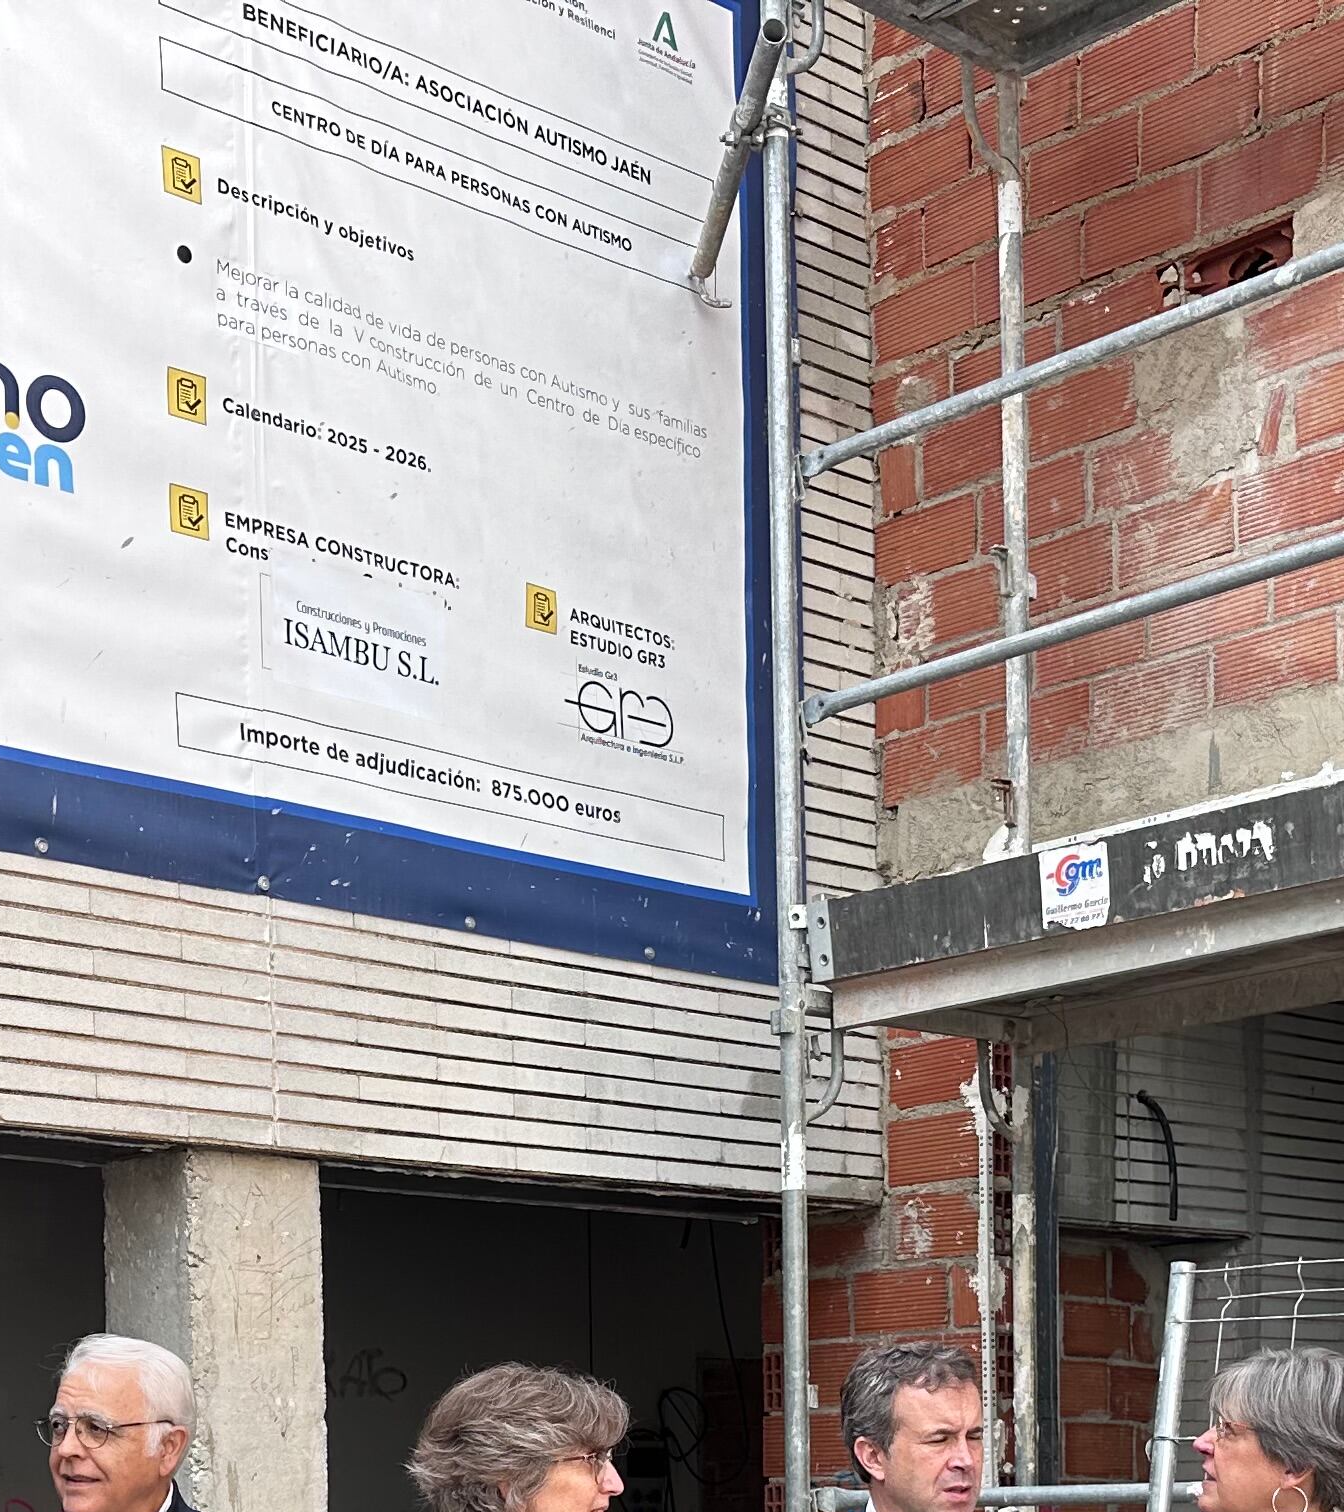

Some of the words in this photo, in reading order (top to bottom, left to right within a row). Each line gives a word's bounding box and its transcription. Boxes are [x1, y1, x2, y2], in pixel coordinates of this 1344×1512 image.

[243, 2, 409, 86] BENEFICIARIO/A:
[416, 75, 528, 136] ASOCIACIÓN
[535, 125, 607, 166] AUTISMO
[611, 156, 651, 185] JAÉN
[271, 101, 341, 137] CENTRO
[346, 128, 366, 150] DE
[371, 140, 399, 164] DÍA
[406, 151, 446, 181] PARA
[451, 170, 530, 213] PERSONAS
[535, 204, 567, 227] CON
[572, 219, 632, 251] AUTISMO
[218, 178, 319, 228] Descripción
[324, 219, 334, 235] y
[339, 226, 414, 261] objetivos
[216, 259, 279, 292] Mejorar
[285, 280, 298, 299] la
[305, 290, 361, 320] calidad
[365, 311, 383, 329] de
[389, 321, 421, 343] vida
[427, 326, 445, 350] de
[451, 341, 515, 375] personas
[520, 366, 546, 385] con
[551, 373, 608, 406] Autismo
[611, 397, 620, 412] y
[629, 403, 650, 420] sus
[658, 409, 707, 439] familias
[217, 312, 255, 335] para
[261, 325, 337, 359] personas
[341, 348, 371, 371] con
[217, 288, 226, 301] a
[237, 291, 288, 321] través
[299, 312, 319, 330] de
[330, 319, 343, 338] la
[354, 327, 364, 343] V
[369, 334, 465, 380] construcción
[474, 369, 492, 389] de
[500, 381, 517, 398] un
[527, 388, 575, 417] Centro
[583, 408, 600, 425] de
[608, 415, 630, 436] Día
[634, 427, 701, 459] específico
[222, 397, 322, 440] Calendario:
[327, 428, 368, 454] 2025
[385, 445, 432, 473] 2026.
[225, 511, 309, 549] EMPRESA
[315, 536, 460, 589] CONSTRUCTORA:
[283, 617, 391, 671] ISAMBU
[397, 650, 440, 685] S.L.
[296, 600, 362, 630] Construcciones
[365, 623, 371, 635] y
[373, 621, 427, 647] Promociones
[570, 608, 676, 651] ARQUITECTOS:
[570, 630, 633, 660] ESTUDIO
[637, 649, 666, 669] GR3
[578, 664, 604, 678] Estudio
[239, 722, 320, 756] Importe
[326, 742, 349, 763] de
[355, 752, 481, 792] adjudicación:
[491, 780, 570, 812] 875.000
[575, 802, 622, 824] euros
